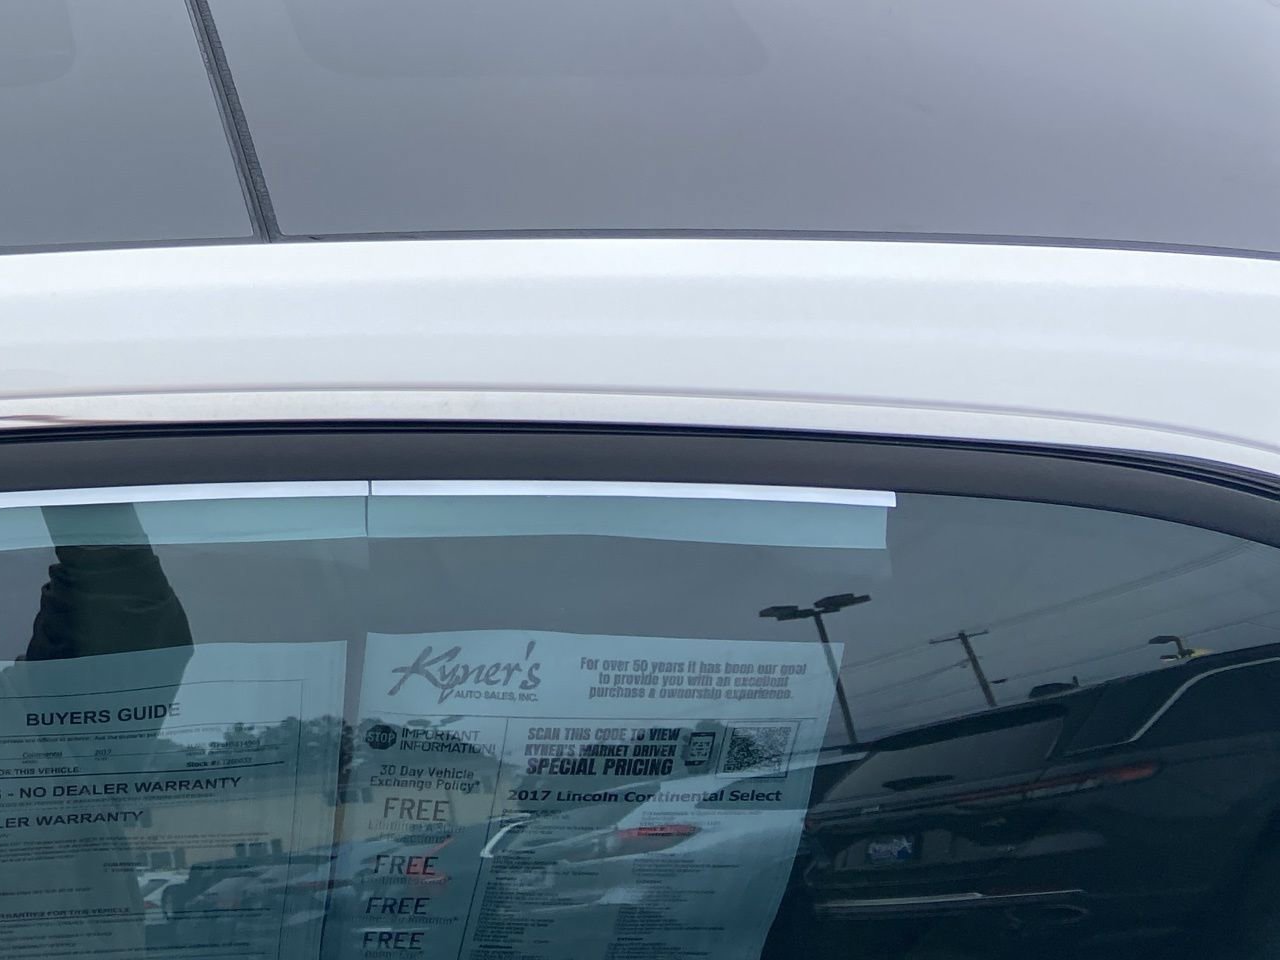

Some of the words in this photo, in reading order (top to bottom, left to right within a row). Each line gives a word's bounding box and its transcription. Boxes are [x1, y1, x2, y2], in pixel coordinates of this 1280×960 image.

[388, 640, 542, 704] Kyner's
[580, 657, 600, 671] For
[602, 659, 631, 672] over
[632, 659, 649, 673] 50
[651, 661, 685, 676] years
[687, 660, 697, 673] it
[698, 660, 722, 674] has
[724, 662, 755, 675] been
[757, 664, 779, 675] our
[780, 663, 807, 677] goal
[599, 672, 611, 685] to
[613, 671, 659, 688] provide
[661, 675, 684, 689] you
[686, 673, 713, 687] with
[716, 675, 731, 687] an
[733, 674, 789, 688] excellent
[455, 690, 483, 701] AUTO
[484, 691, 516, 702] SALES,
[518, 692, 539, 702] INC.
[588, 685, 646, 700] purchase
[659, 687, 721, 702] ownership
[26, 710, 111, 727] BUYERS
[118, 702, 181, 722] GUIDE
[366, 730, 396, 744] STOP
[401, 727, 481, 741] IMPORTANT
[527, 727, 562, 742] SCAN
[563, 727, 593, 741] THIS
[594, 727, 628, 742] CODE
[629, 727, 647, 741] TO
[648, 727, 681, 741] VIEW
[399, 740, 497, 755] INFORMATION!
[524, 743, 576, 758] KYNER'S
[578, 743, 631, 758] MARKET
[633, 743, 677, 757] DRIVEN
[13, 767, 36, 776] THIS
[379, 764, 396, 776] 30
[399, 765, 424, 779] Day
[428, 767, 475, 780] Vehicle
[526, 757, 599, 776] SPECIAL
[602, 758, 673, 776] PRICING
[19, 786, 48, 800] NO
[52, 783, 130, 798] DEALER
[132, 776, 243, 794] WARRANTY
[370, 775, 433, 790] Exchange
[507, 790, 551, 802] 2017
[556, 790, 618, 803] Lincoln
[623, 790, 724, 803] Continental
[728, 790, 782, 803] Select
[383, 797, 450, 822] FREE
[35, 810, 145, 827] WARRANTY
[373, 854, 439, 876] FREE
[366, 897, 430, 915] FREE
[362, 932, 425, 951] FREE
